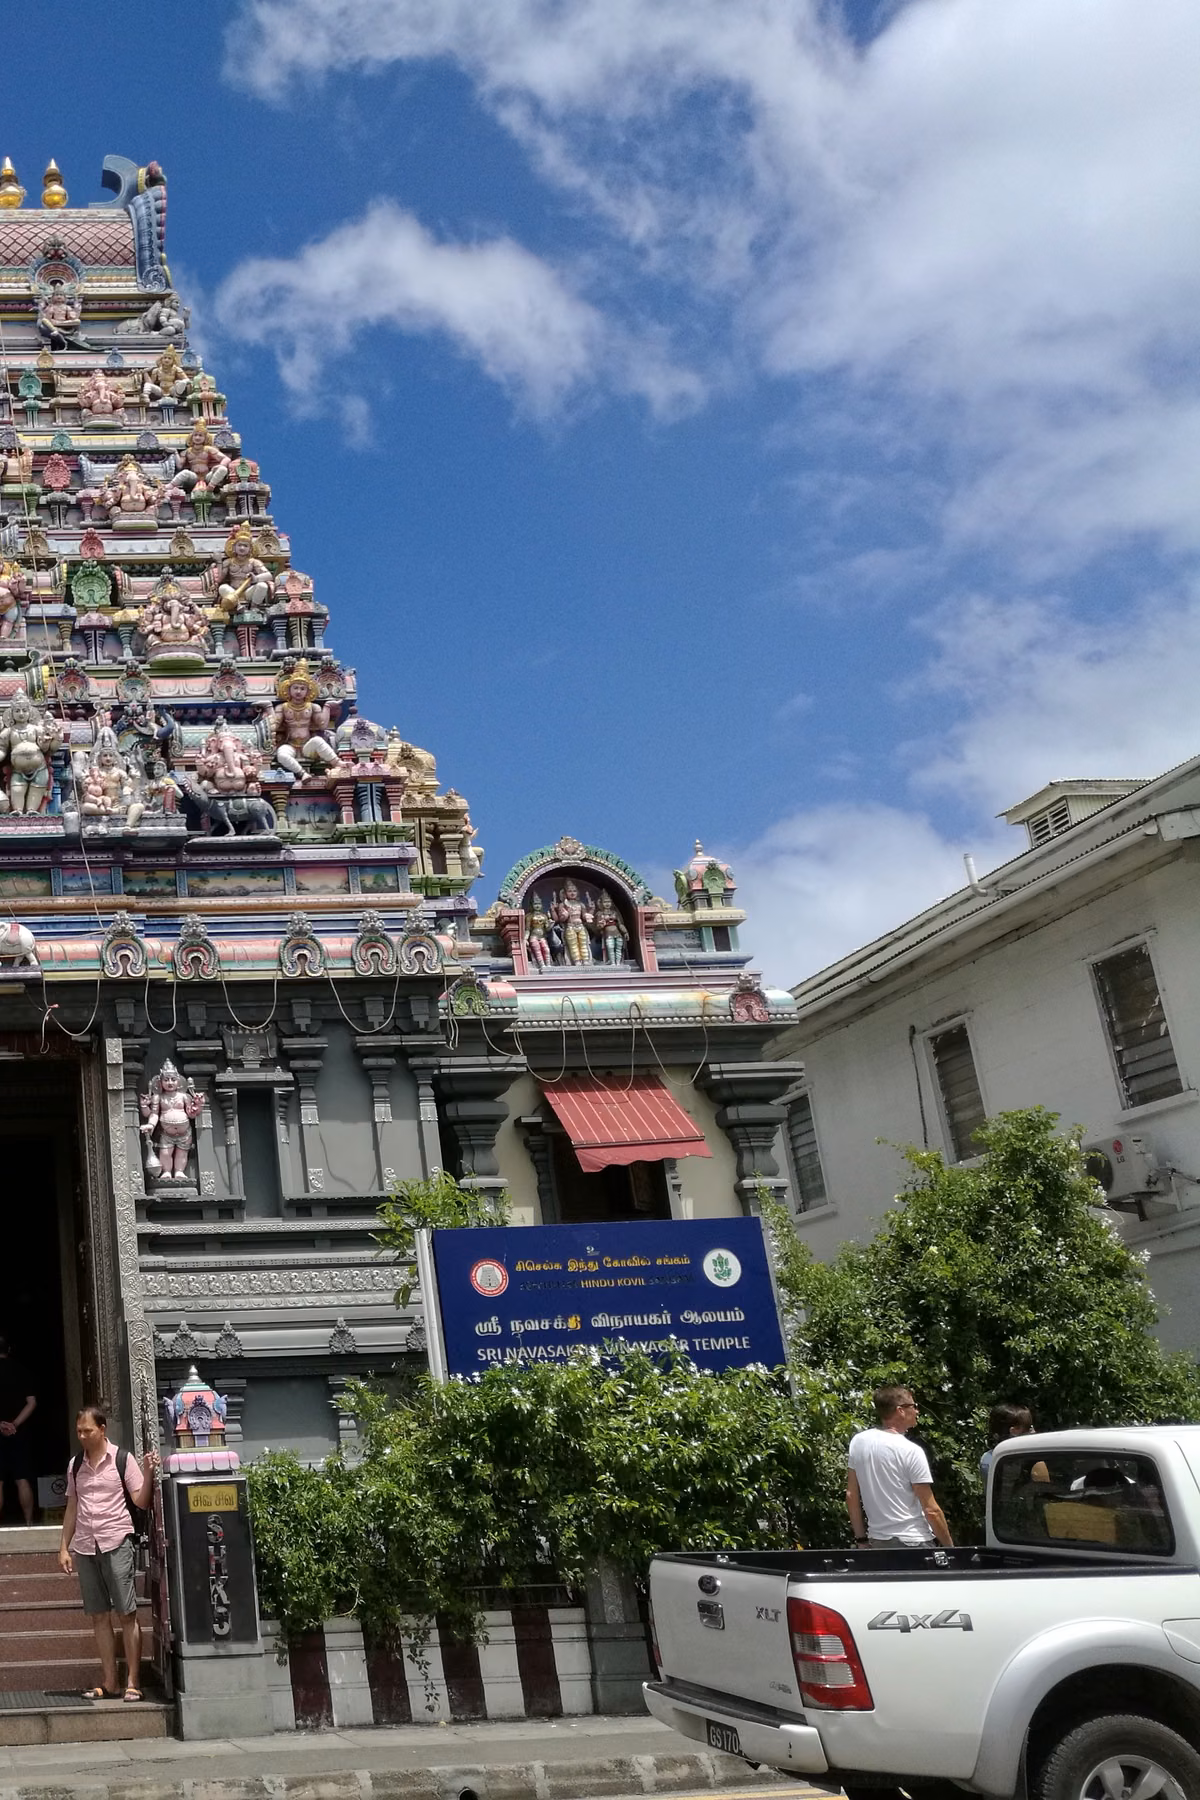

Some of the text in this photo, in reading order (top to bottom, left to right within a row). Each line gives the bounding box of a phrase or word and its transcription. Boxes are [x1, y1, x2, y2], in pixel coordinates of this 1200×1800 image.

[603, 1255, 651, 1268] கோவில்
[581, 1278, 615, 1288] HINDU
[617, 1277, 646, 1287] KOVIL
[510, 1313, 582, 1336] நவசக்தி
[591, 1310, 672, 1331] விநாயகர்
[680, 1306, 745, 1325] ஆலயம்
[477, 1347, 502, 1361] SRI
[692, 1336, 751, 1351] TEMPLE
[755, 1606, 781, 1622] XLT
[867, 1609, 973, 1633] 4x4
[710, 1725, 744, 1756] GS170
